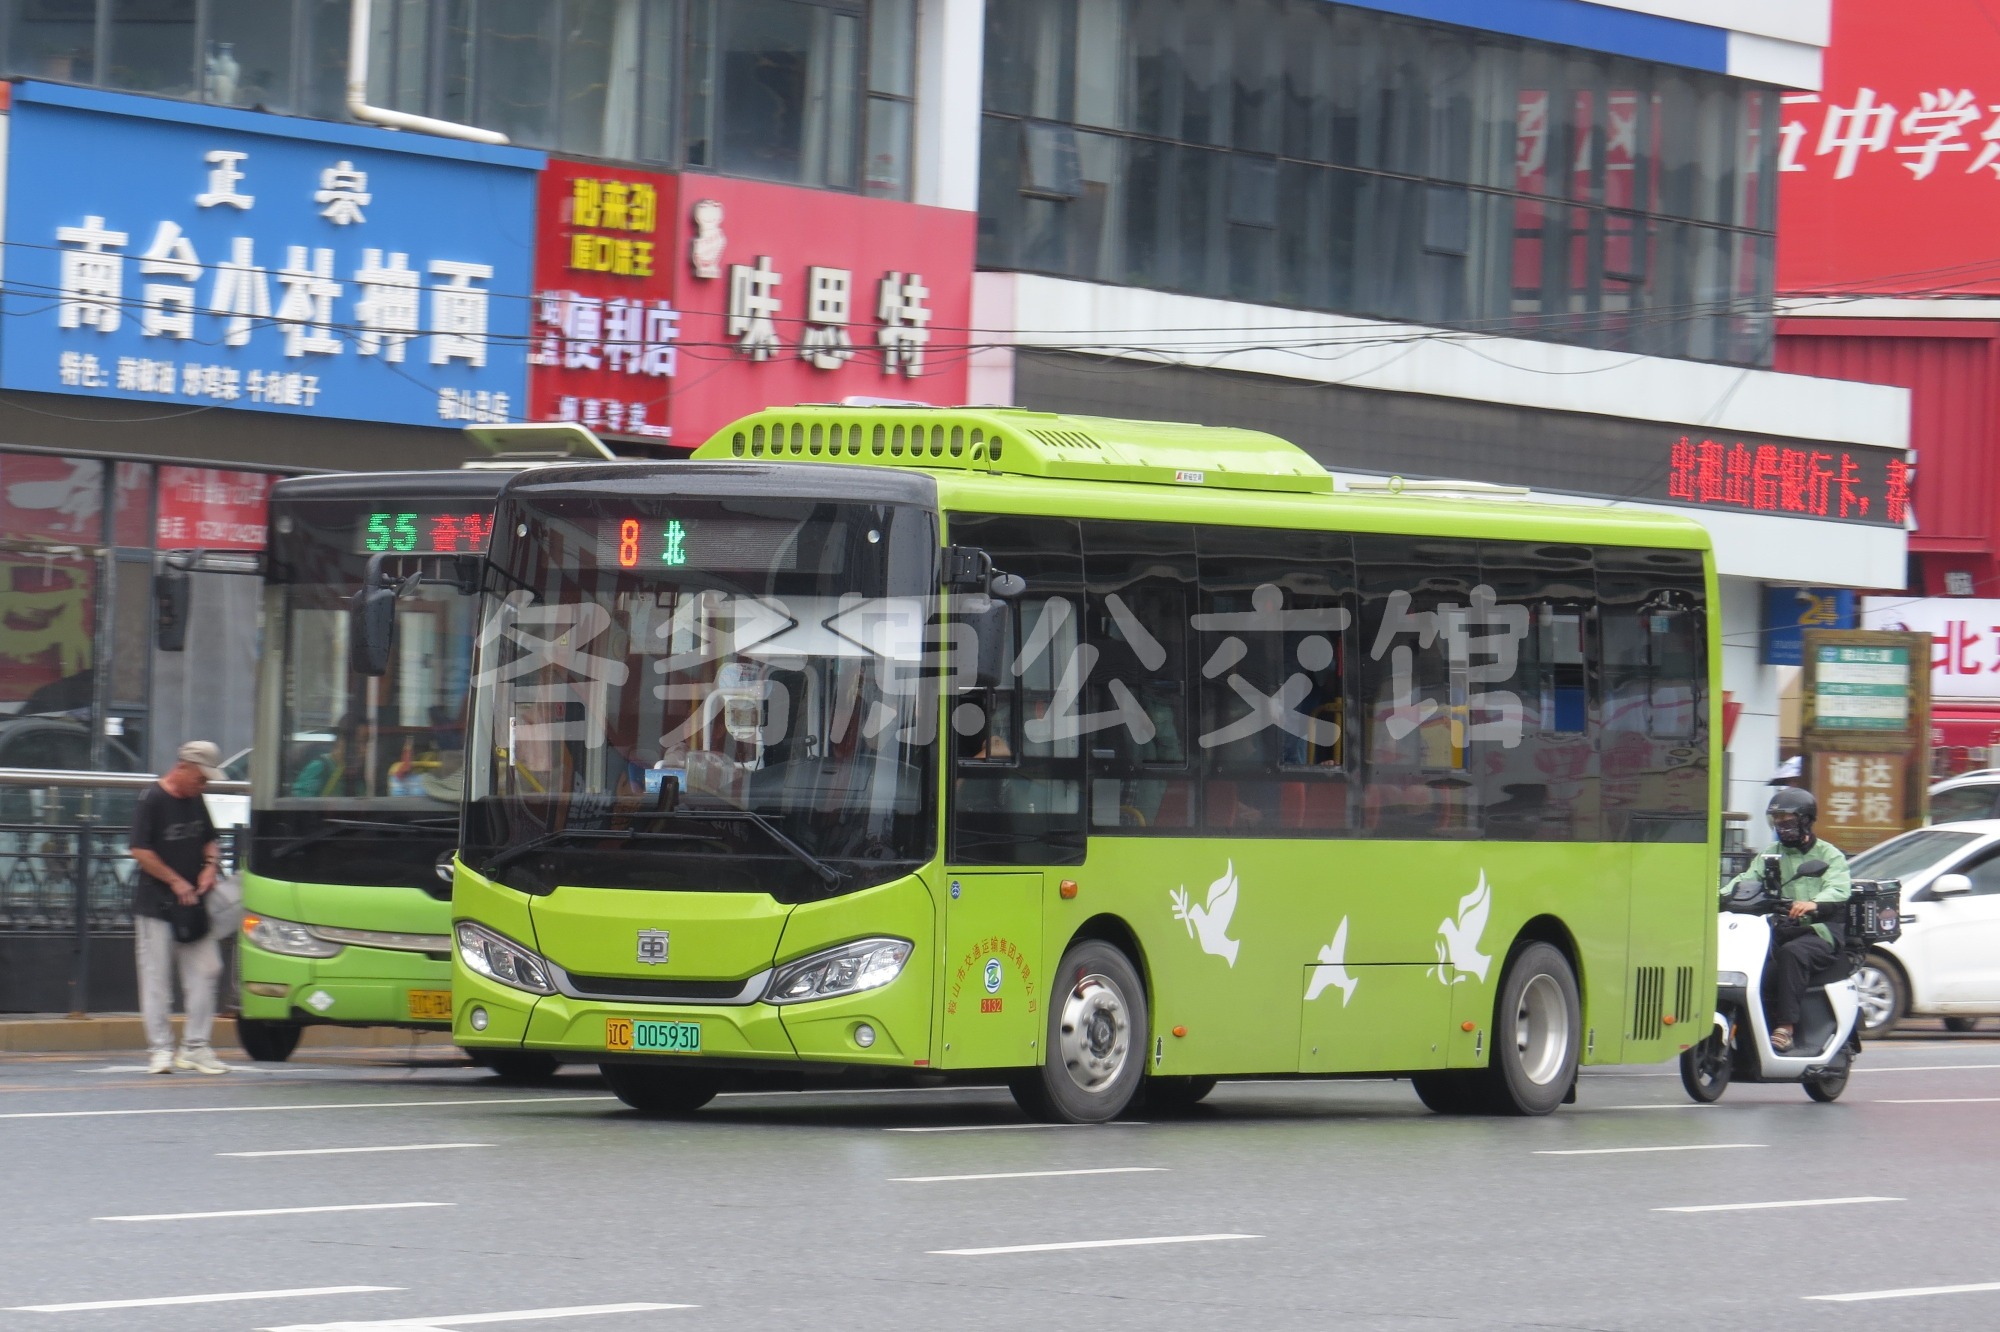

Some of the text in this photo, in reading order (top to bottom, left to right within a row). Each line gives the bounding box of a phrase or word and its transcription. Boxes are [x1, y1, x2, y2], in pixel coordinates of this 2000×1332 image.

[195, 150, 372, 225] 正宗
[563, 291, 682, 377] 便利店
[727, 255, 931, 378] 味思特
[366, 513, 418, 551] 55
[620, 519, 639, 567] 8
[662, 520, 686, 566] 北
[1931, 620, 2000, 676] 北
[1827, 792, 1893, 824] 学校
[948, 936, 1037, 1015] 鞍山市交通运输集团有限公司
[981, 999, 1002, 1013] 3132
